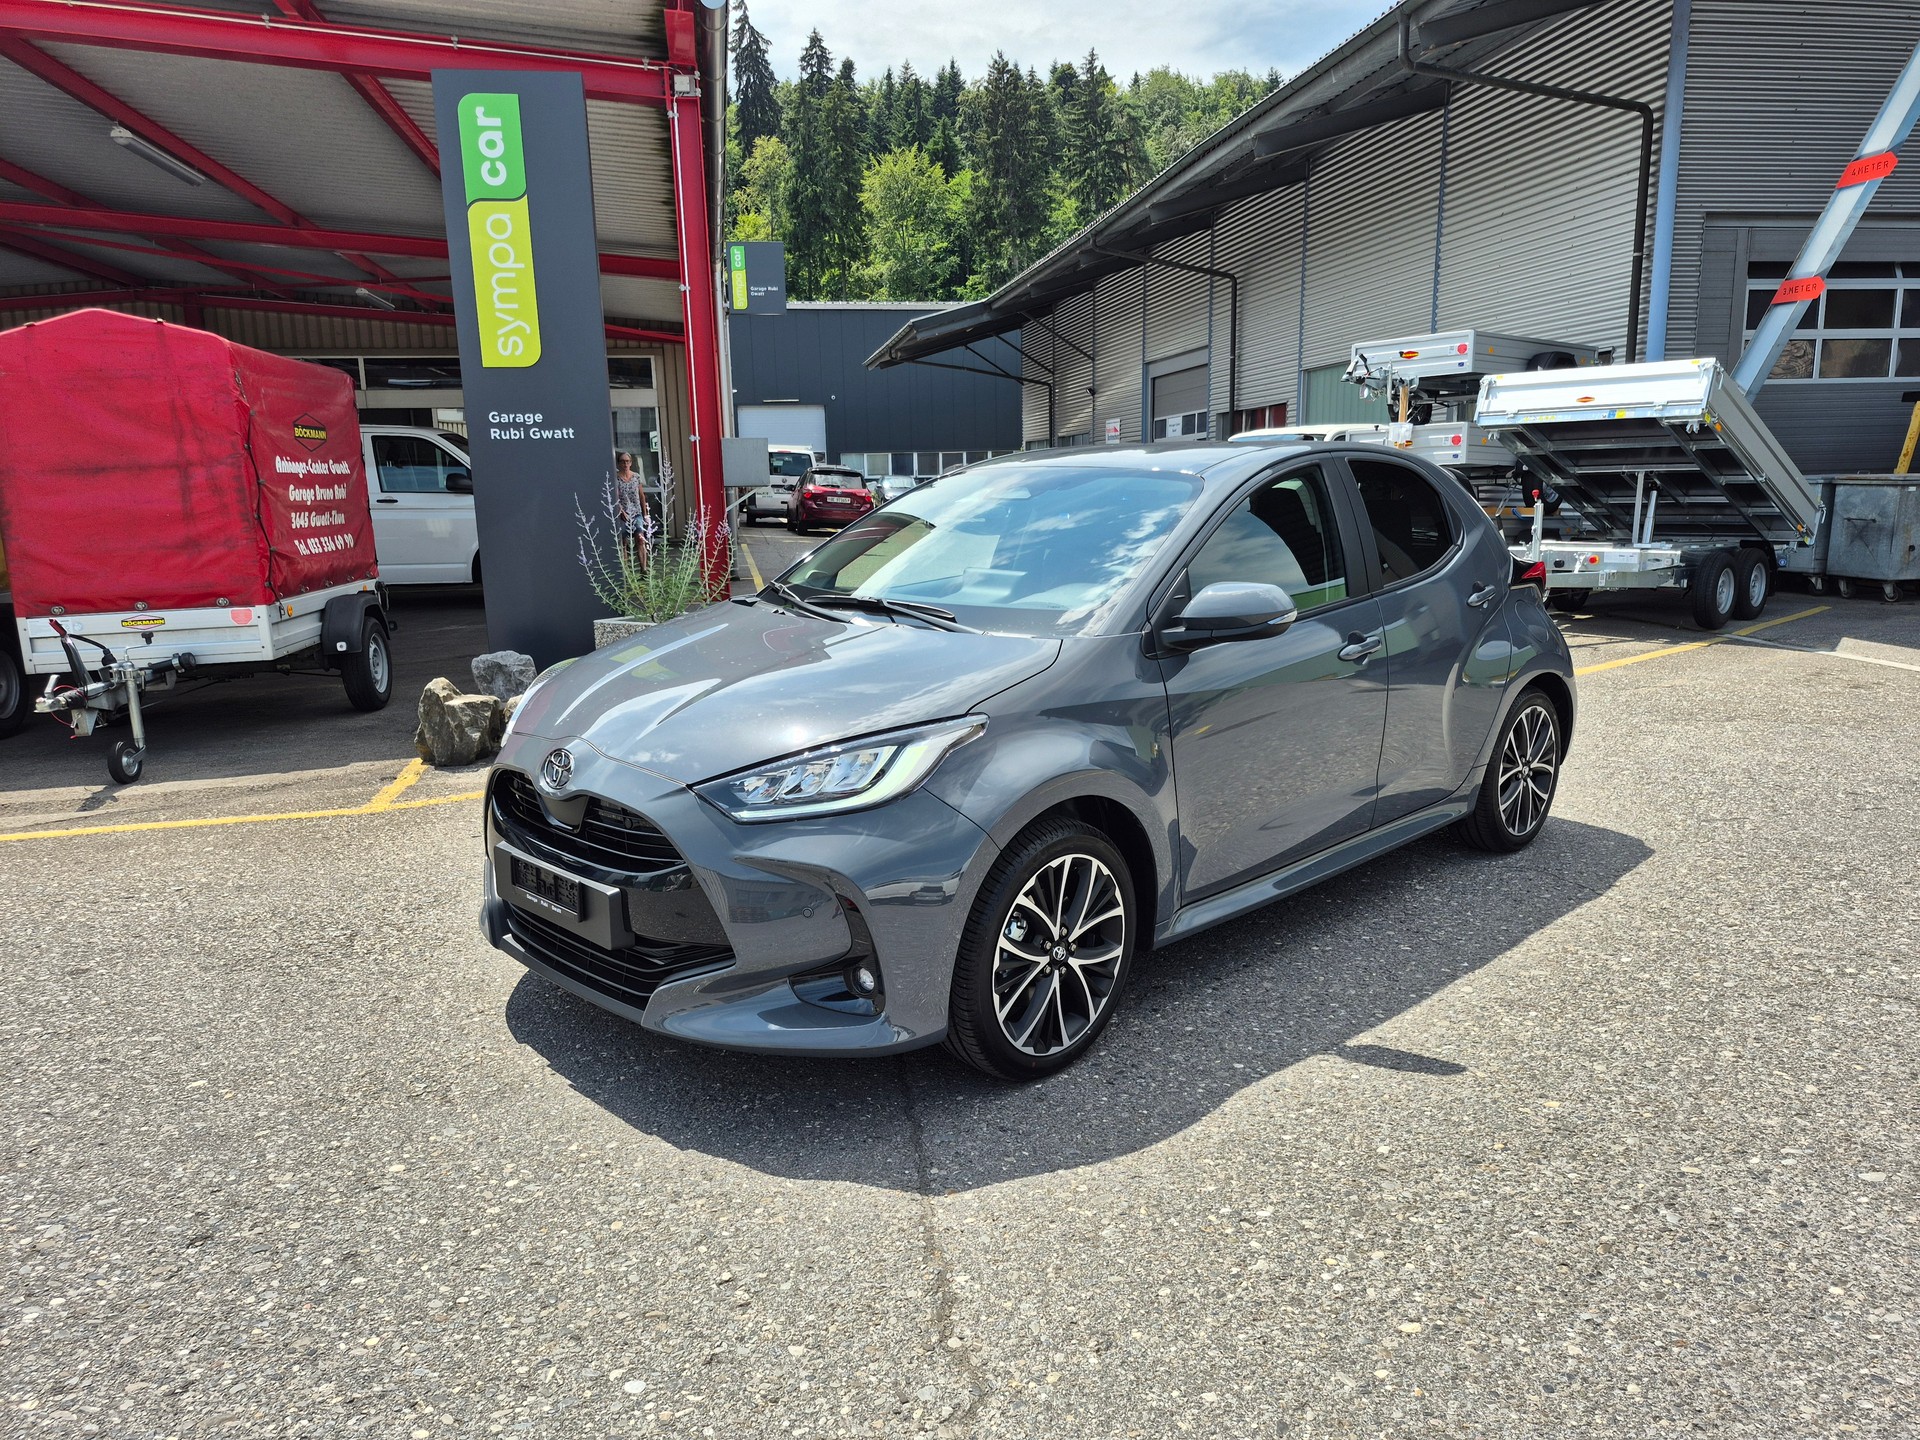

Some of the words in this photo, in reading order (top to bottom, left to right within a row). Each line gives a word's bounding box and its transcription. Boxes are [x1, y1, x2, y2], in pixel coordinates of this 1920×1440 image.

[475, 106, 507, 187] car
[486, 213, 531, 357] sympa
[488, 411, 543, 425] Garage
[490, 428, 525, 440] Rubi
[529, 428, 575, 440] Gwatt
[328, 459, 351, 475] Gwatt
[288, 484, 315, 506] Garage
[315, 484, 334, 501] Bruno
[334, 482, 347, 500] Rubi
[290, 512, 309, 529] 3645
[310, 510, 345, 527] Gwatt-Thun
[293, 538, 311, 556] Tel.
[306, 537, 323, 555] 033
[320, 535, 336, 553] 336
[334, 534, 345, 550] 69
[343, 533, 354, 549] 90
